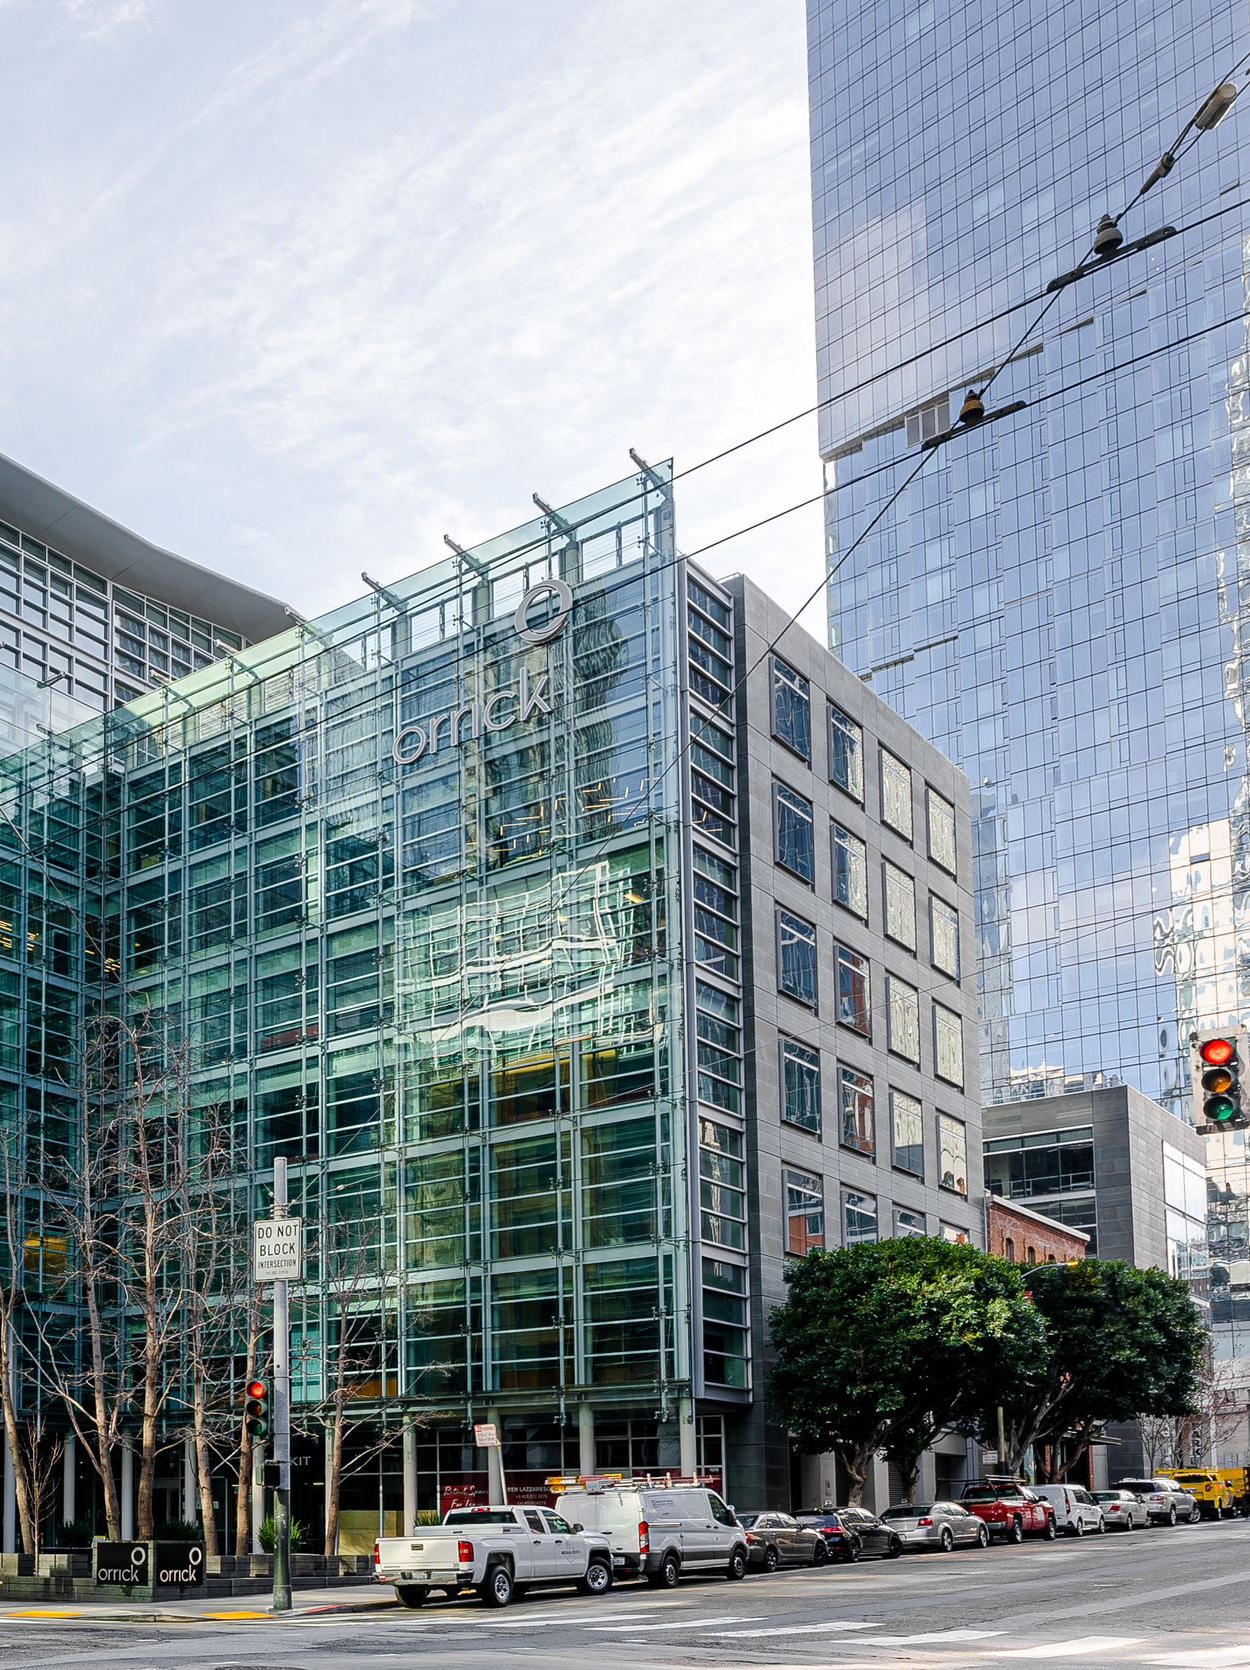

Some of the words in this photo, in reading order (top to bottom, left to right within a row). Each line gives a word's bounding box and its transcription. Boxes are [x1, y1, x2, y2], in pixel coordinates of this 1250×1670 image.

[392, 667, 552, 765] orrick
[258, 1227, 272, 1239] DO
[277, 1225, 298, 1237] NOT
[260, 1243, 295, 1256] BLOCK
[258, 1259, 296, 1269] INTERSECTION
[98, 1564, 139, 1582] orrick
[160, 1564, 197, 1583] orrick
